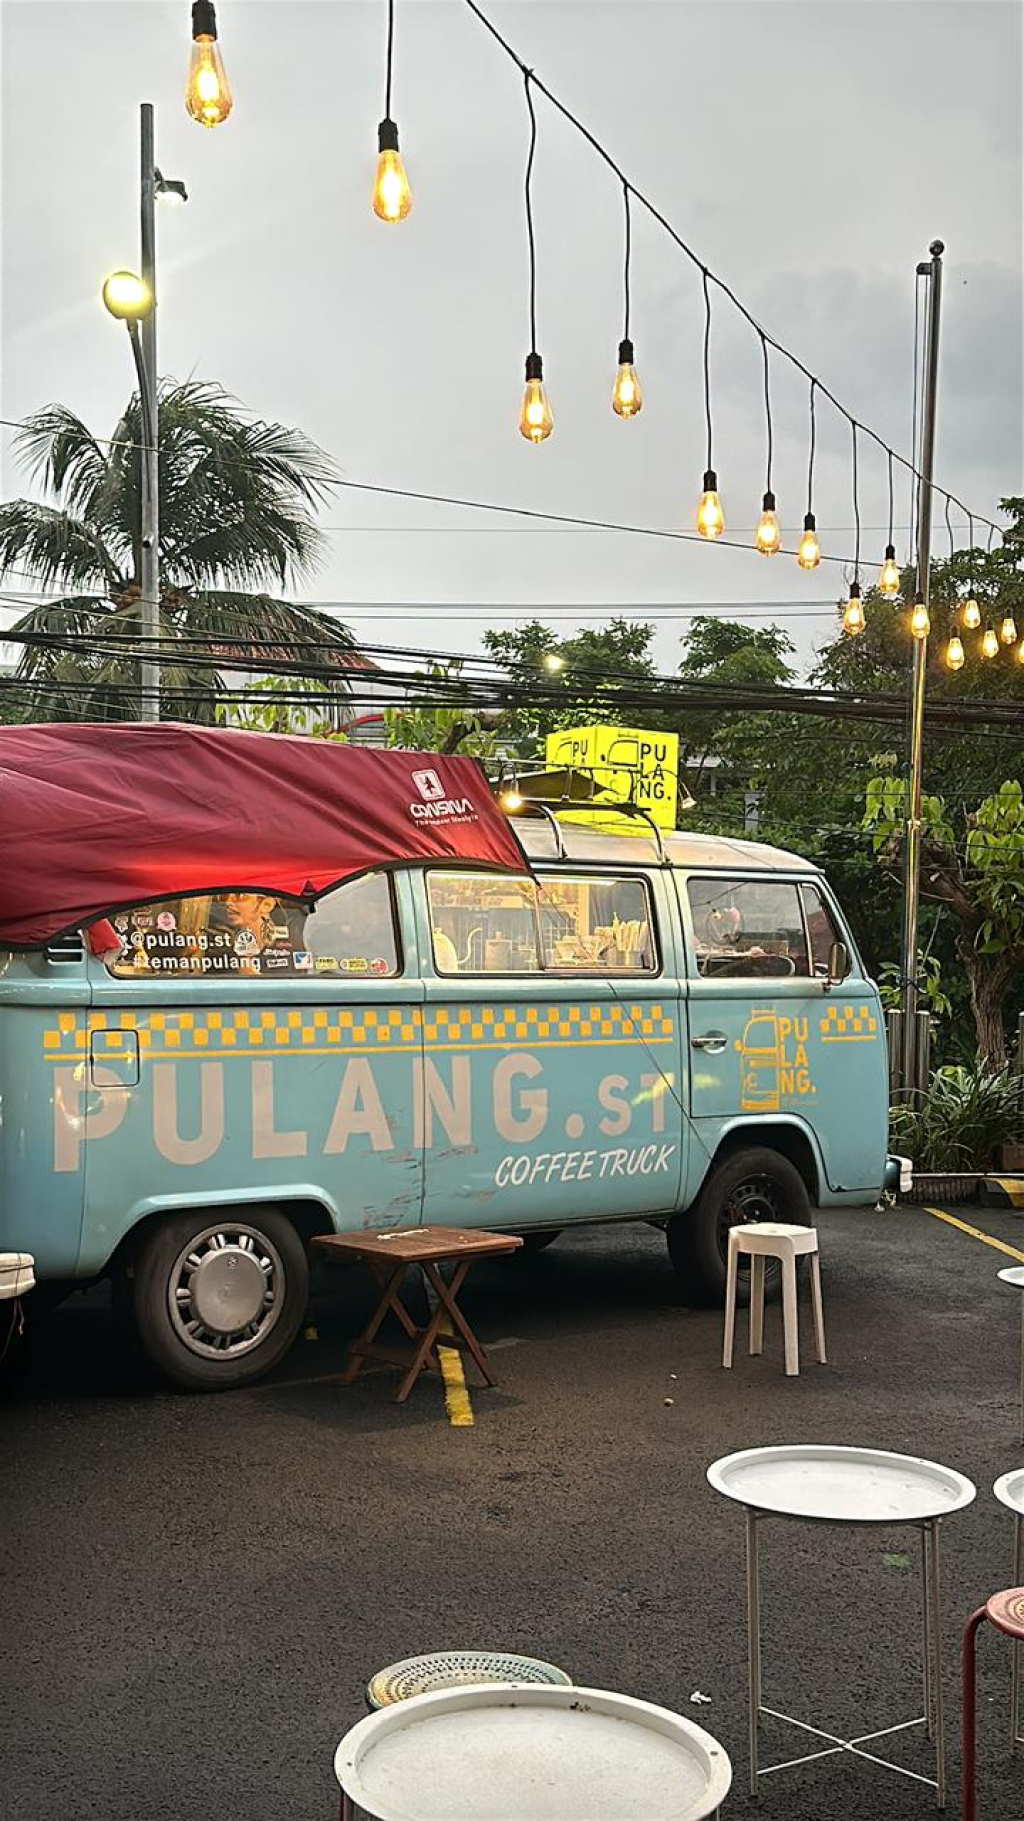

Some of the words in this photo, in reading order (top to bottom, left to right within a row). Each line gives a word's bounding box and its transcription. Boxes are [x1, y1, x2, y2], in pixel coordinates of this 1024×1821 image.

[573, 740, 588, 757] PU
[641, 743, 666, 762] PU
[641, 762, 664, 781] LA
[640, 781, 672, 801] NG.
[130, 931, 232, 950] @pulang.st
[133, 954, 262, 975] #temanpulang
[779, 1016, 809, 1042] PU
[779, 1043, 809, 1068] LA
[780, 1069, 817, 1094] NG.
[495, 1151, 597, 1187] COFFEE
[599, 1145, 676, 1178] TRUCK
